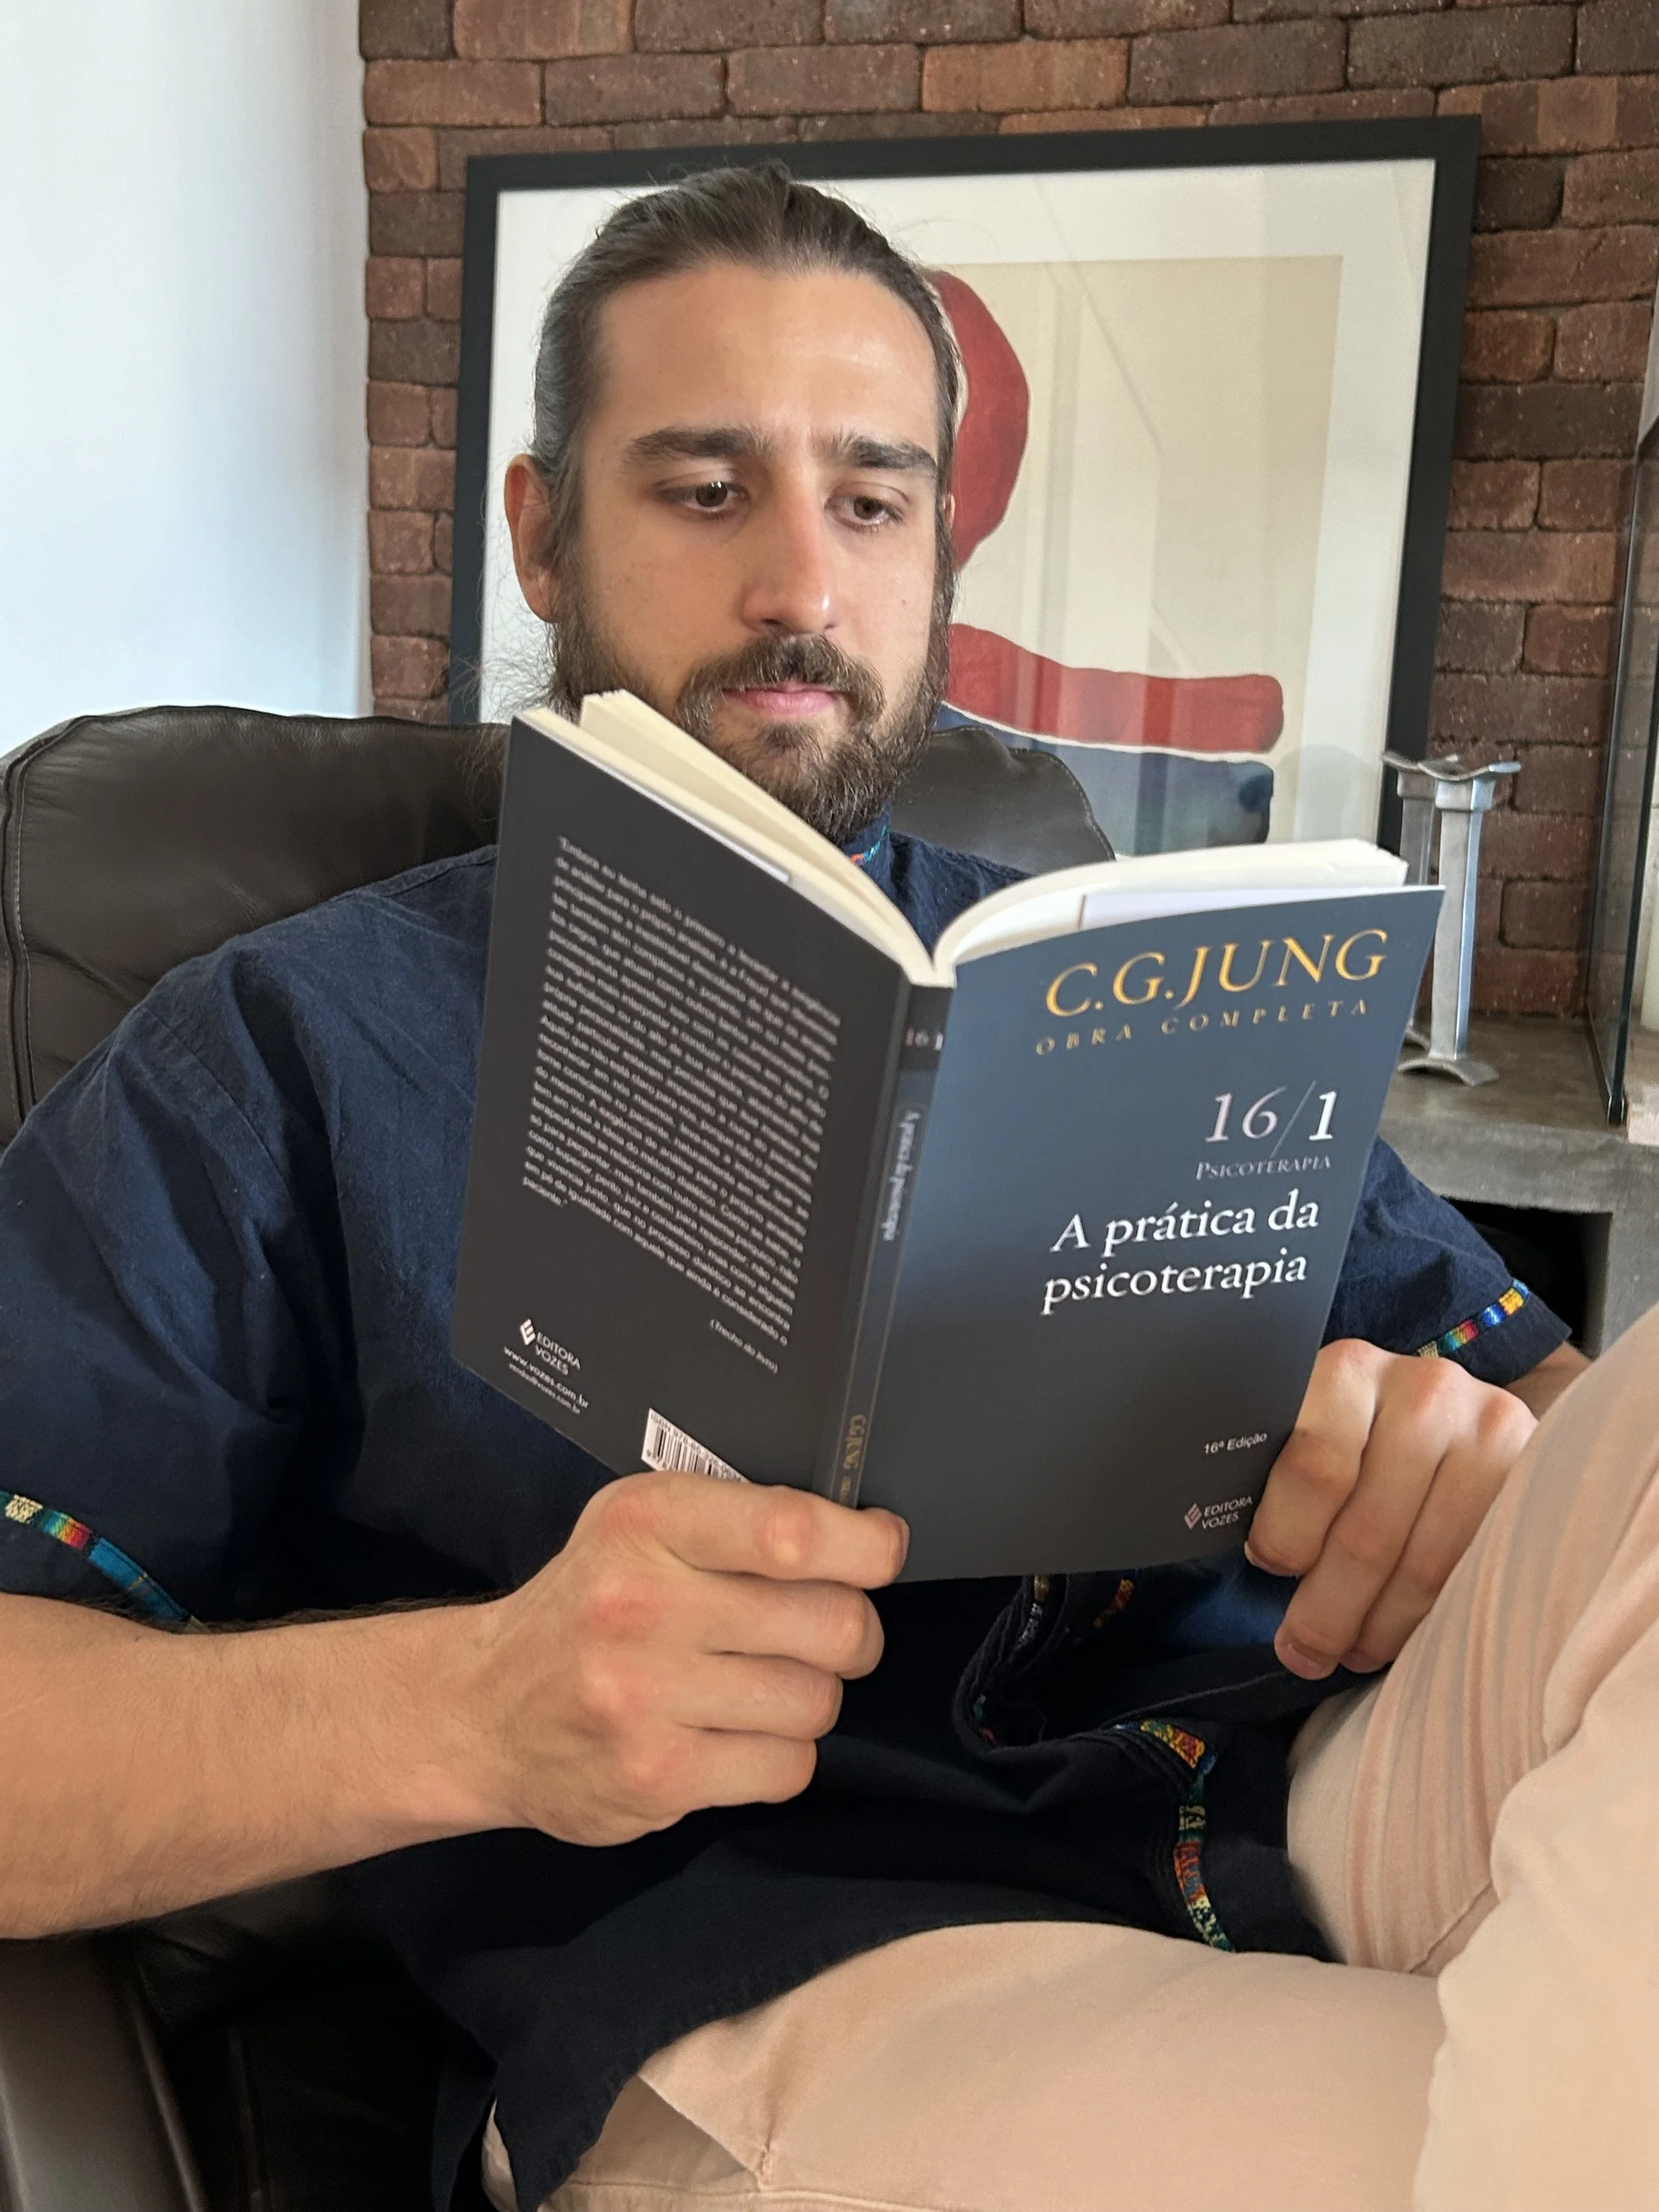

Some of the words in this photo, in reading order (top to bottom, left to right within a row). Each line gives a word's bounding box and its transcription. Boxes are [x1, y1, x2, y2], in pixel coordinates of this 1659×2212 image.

[1036, 1024, 1132, 1056] OBRA
[1161, 999, 1366, 1035] COMPLETA
[1204, 1078, 1338, 1159] 16/1
[1049, 1213, 1092, 1252] A
[1100, 1202, 1257, 1258] prática
[1268, 1188, 1320, 1230] da
[1040, 1247, 1308, 1315] psicoterapia
[536, 1331, 581, 1370] EDITORA
[536, 1344, 569, 1376] VOZES
[504, 1346, 589, 1408] www.vozes.com.br
[1227, 1432, 1267, 1451] Edição
[1201, 1511, 1240, 1529] VOZES
[1204, 1495, 1253, 1517] EDITORA
